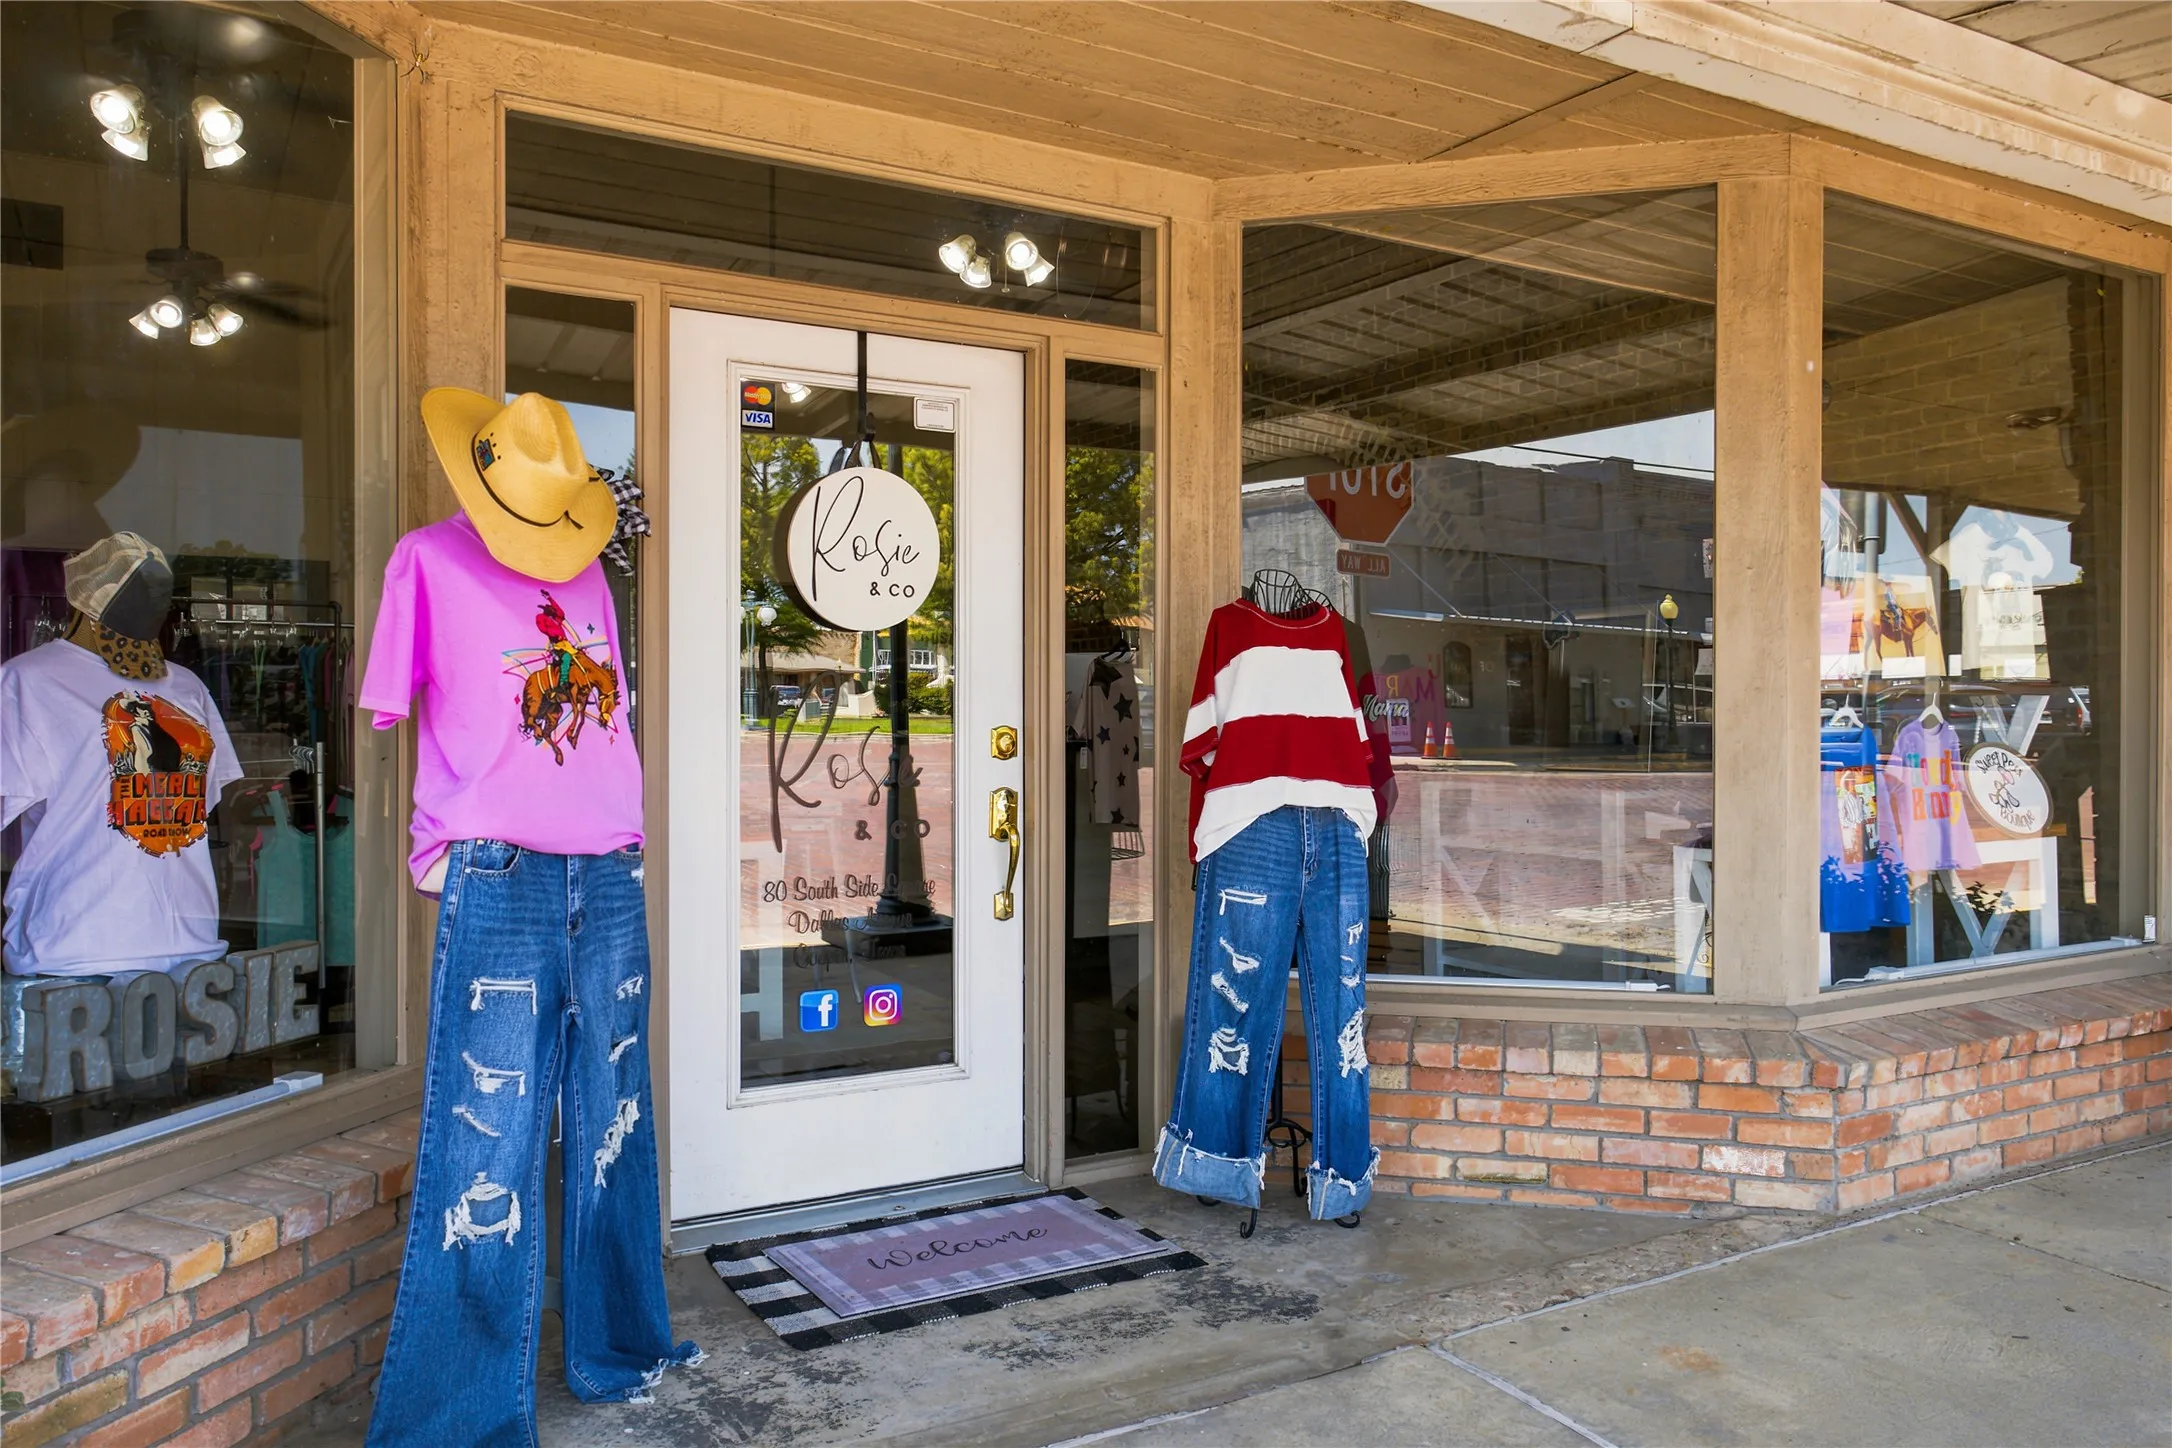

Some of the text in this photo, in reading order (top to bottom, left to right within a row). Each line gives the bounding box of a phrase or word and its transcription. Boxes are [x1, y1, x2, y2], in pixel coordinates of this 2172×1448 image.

[745, 413, 771, 424] VISA
[812, 475, 920, 602] Rosie
[869, 581, 915, 598] & CO
[131, 771, 207, 799] MERL
[854, 819, 872, 841] &
[763, 880, 788, 903] 80
[793, 876, 839, 901] South
[845, 873, 881, 898] Side
[18, 940, 321, 1103] ROSIE
[867, 1227, 1048, 1270] Welcome
